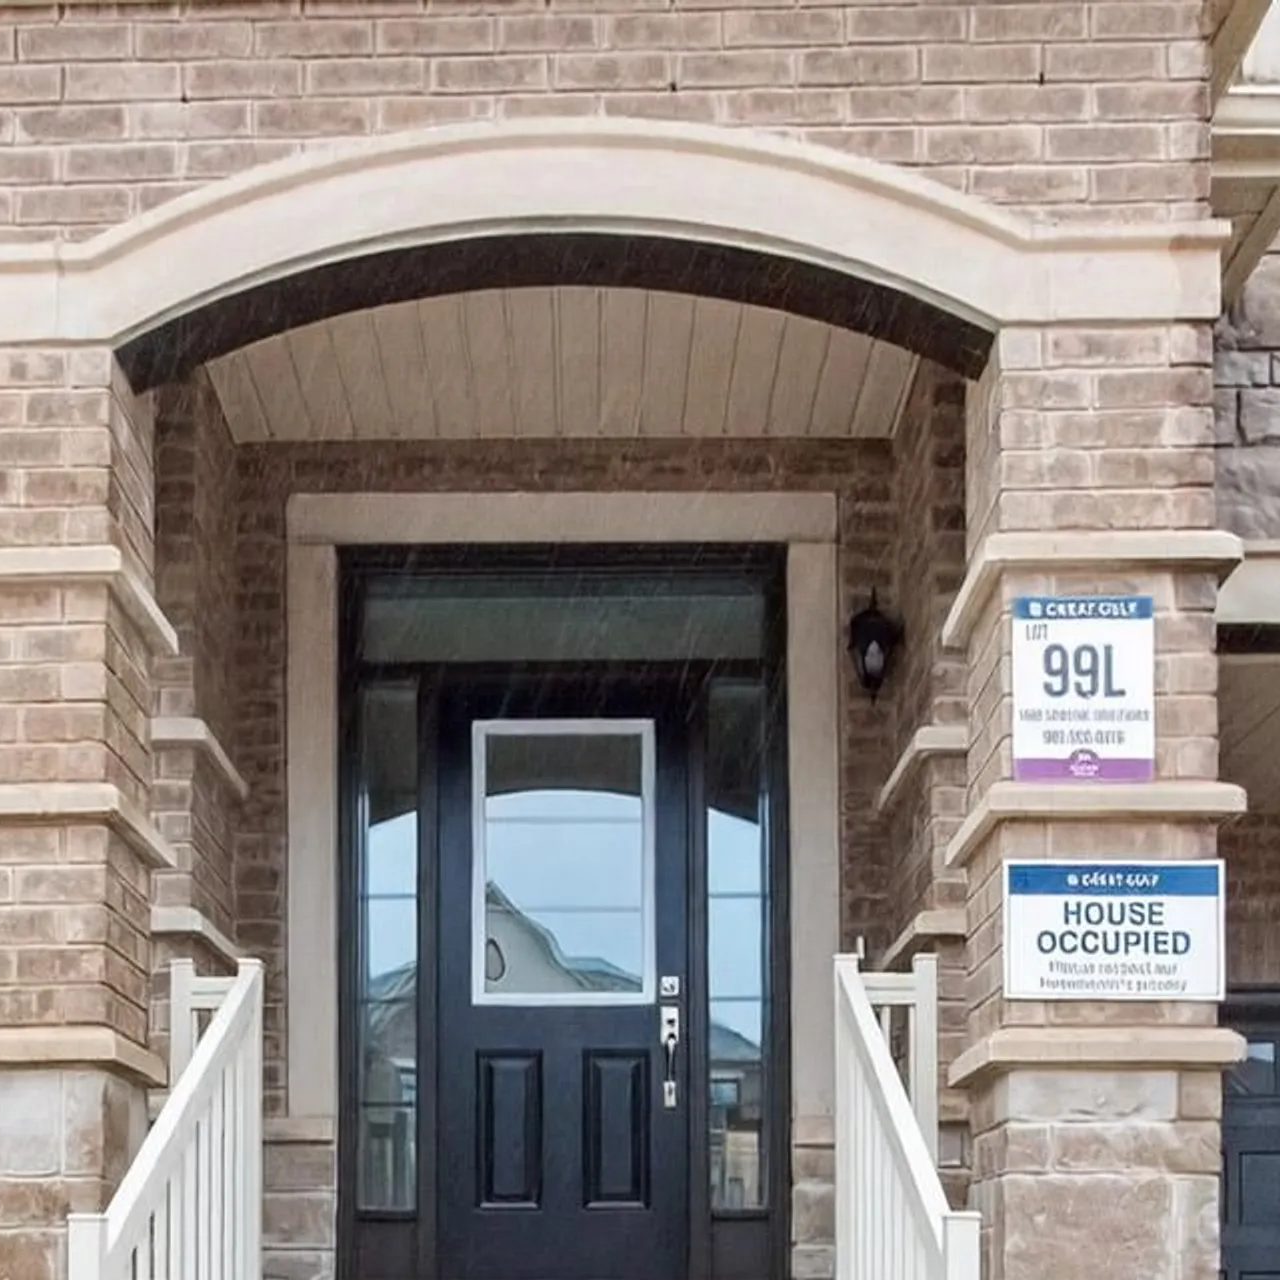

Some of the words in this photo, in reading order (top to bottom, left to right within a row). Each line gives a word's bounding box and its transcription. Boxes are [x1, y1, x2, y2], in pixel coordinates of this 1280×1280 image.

[1042, 643, 1126, 699] 99L
[1063, 901, 1165, 926] HOUSE
[1037, 930, 1191, 955] OCCUPIED
